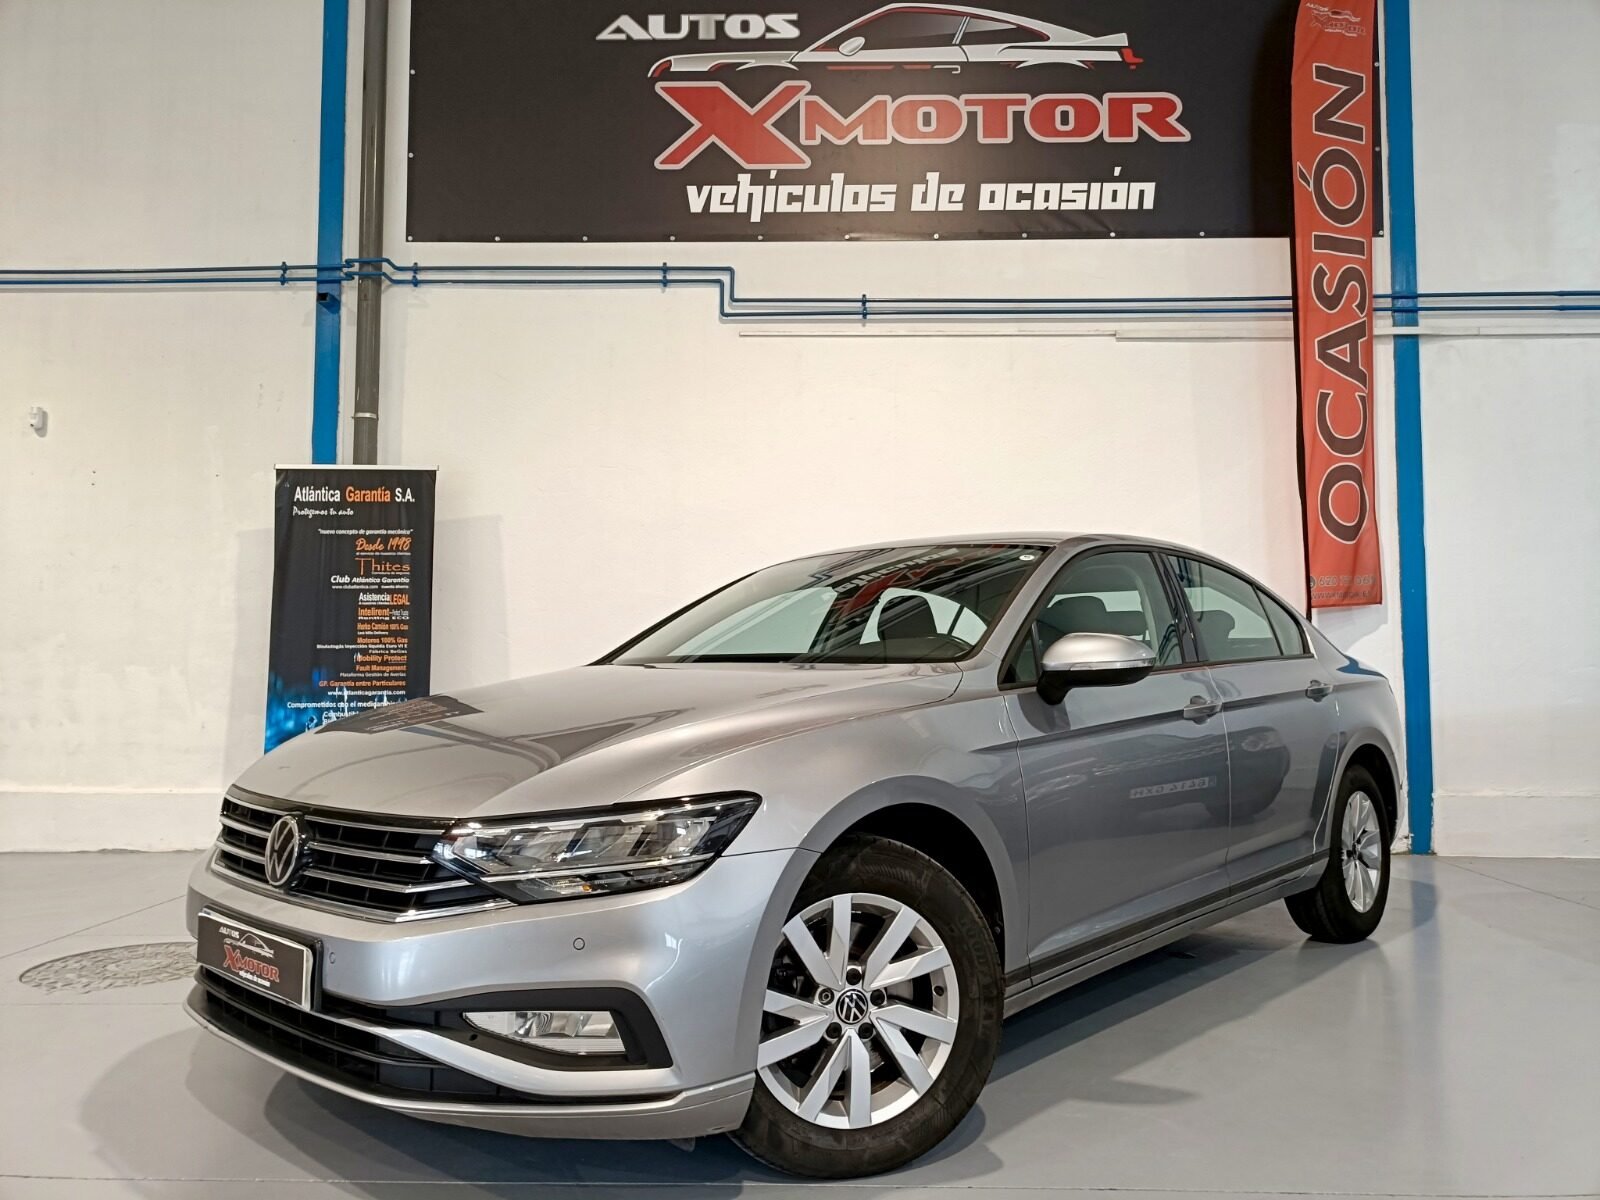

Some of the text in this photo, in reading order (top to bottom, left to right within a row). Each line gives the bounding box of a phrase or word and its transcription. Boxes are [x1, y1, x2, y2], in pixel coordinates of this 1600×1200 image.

[595, 13, 801, 40] AUTOS
[654, 80, 1191, 170] XMOTOR
[686, 166, 1156, 222] vehículos de ocasión
[1297, 63, 1369, 544] OCASIÓN
[294, 485, 415, 502] Atlántica Garantía S.A.
[356, 536, 411, 551] Desde 1998
[330, 574, 350, 583] Club
[287, 701, 337, 709] Comprometidos
